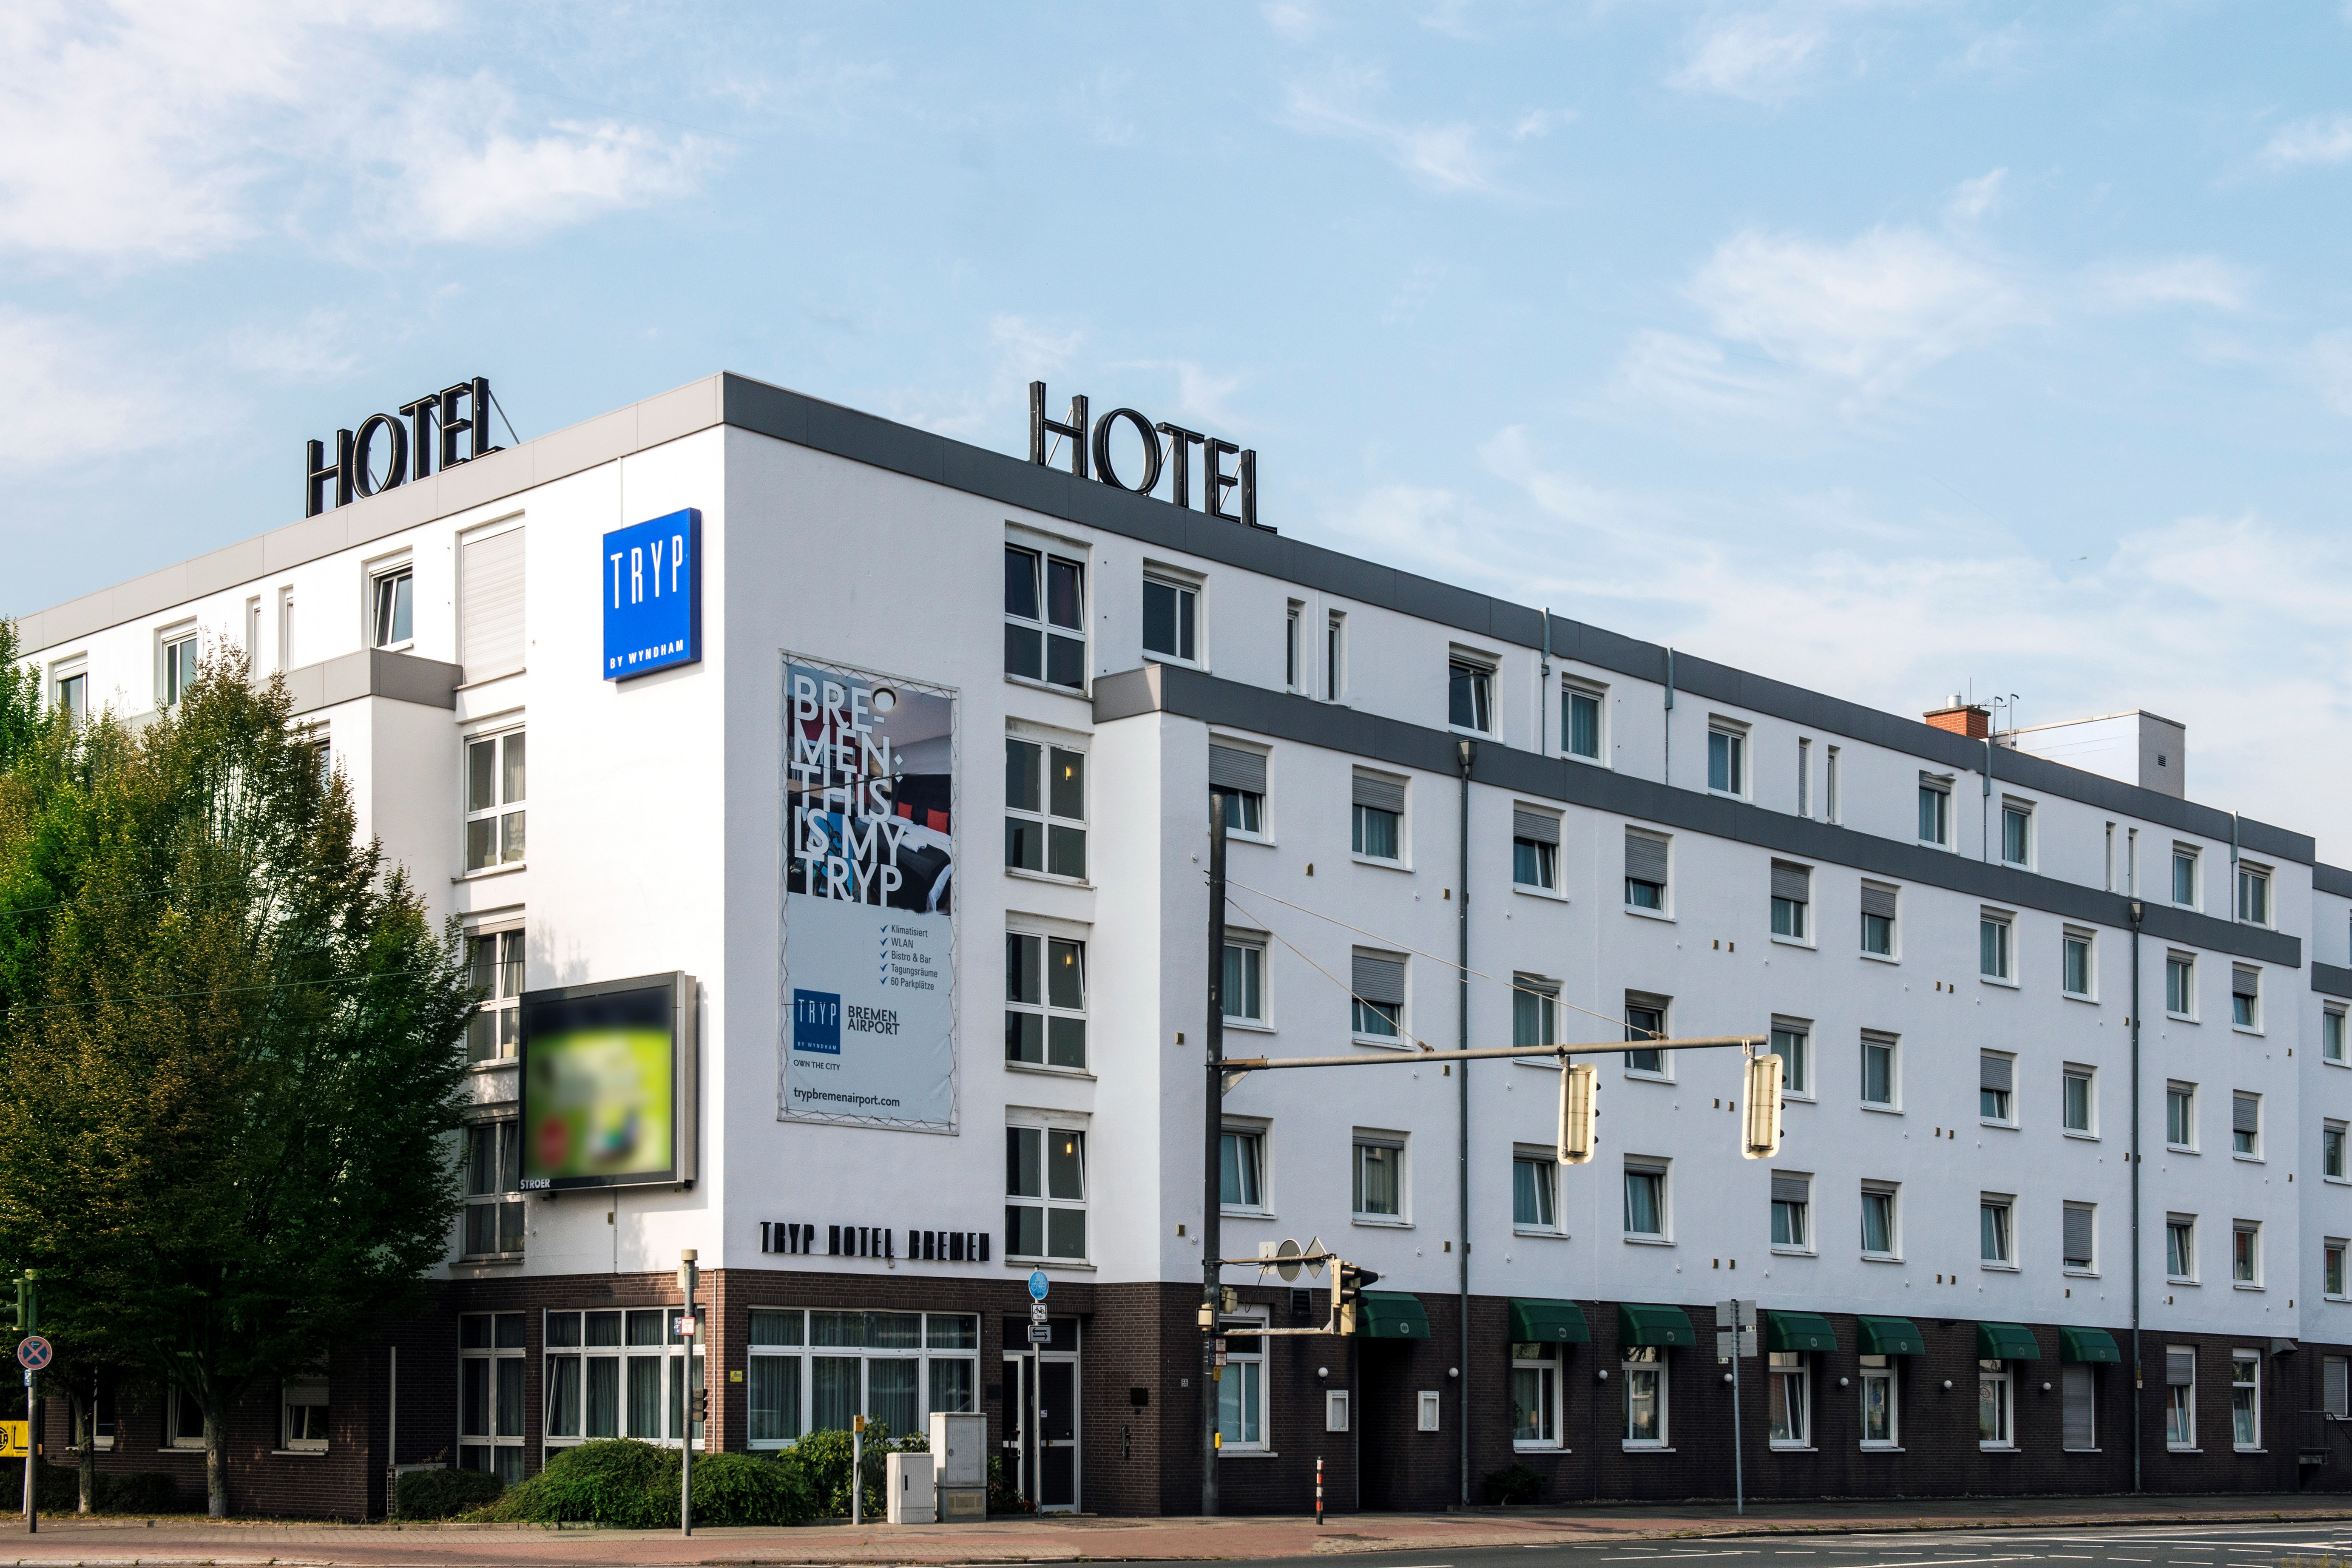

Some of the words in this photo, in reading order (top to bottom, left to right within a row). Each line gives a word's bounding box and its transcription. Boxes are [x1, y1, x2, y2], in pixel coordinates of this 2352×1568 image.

[306, 376, 506, 518] HOTEL
[1029, 381, 1277, 534] HOTEL
[611, 535, 683, 608] TRYP
[610, 656, 622, 669] BY
[629, 639, 683, 664] WYNDHAM
[794, 674, 884, 733] BRE-
[790, 761, 891, 821] THIS
[795, 806, 829, 855] IS
[842, 814, 907, 866] MY
[795, 849, 902, 907] TRYP
[891, 924, 928, 937] Klimatisiert
[891, 937, 913, 948] WLAN
[891, 950, 911, 961] Bistro
[912, 953, 918, 962] &
[920, 954, 931, 963] Bar
[891, 963, 937, 977] Tagungsräume
[891, 977, 899, 986] 60
[901, 978, 934, 990] Parkplätze
[798, 999, 836, 1025] TRYP
[848, 1006, 897, 1023] BREMEN
[848, 1018, 900, 1035] AIRPORT
[794, 1087, 900, 1107] trypbremenairport.com
[760, 1221, 814, 1254] TRYP
[829, 1225, 894, 1258] HOTEL
[909, 1230, 989, 1261] BREMEN
